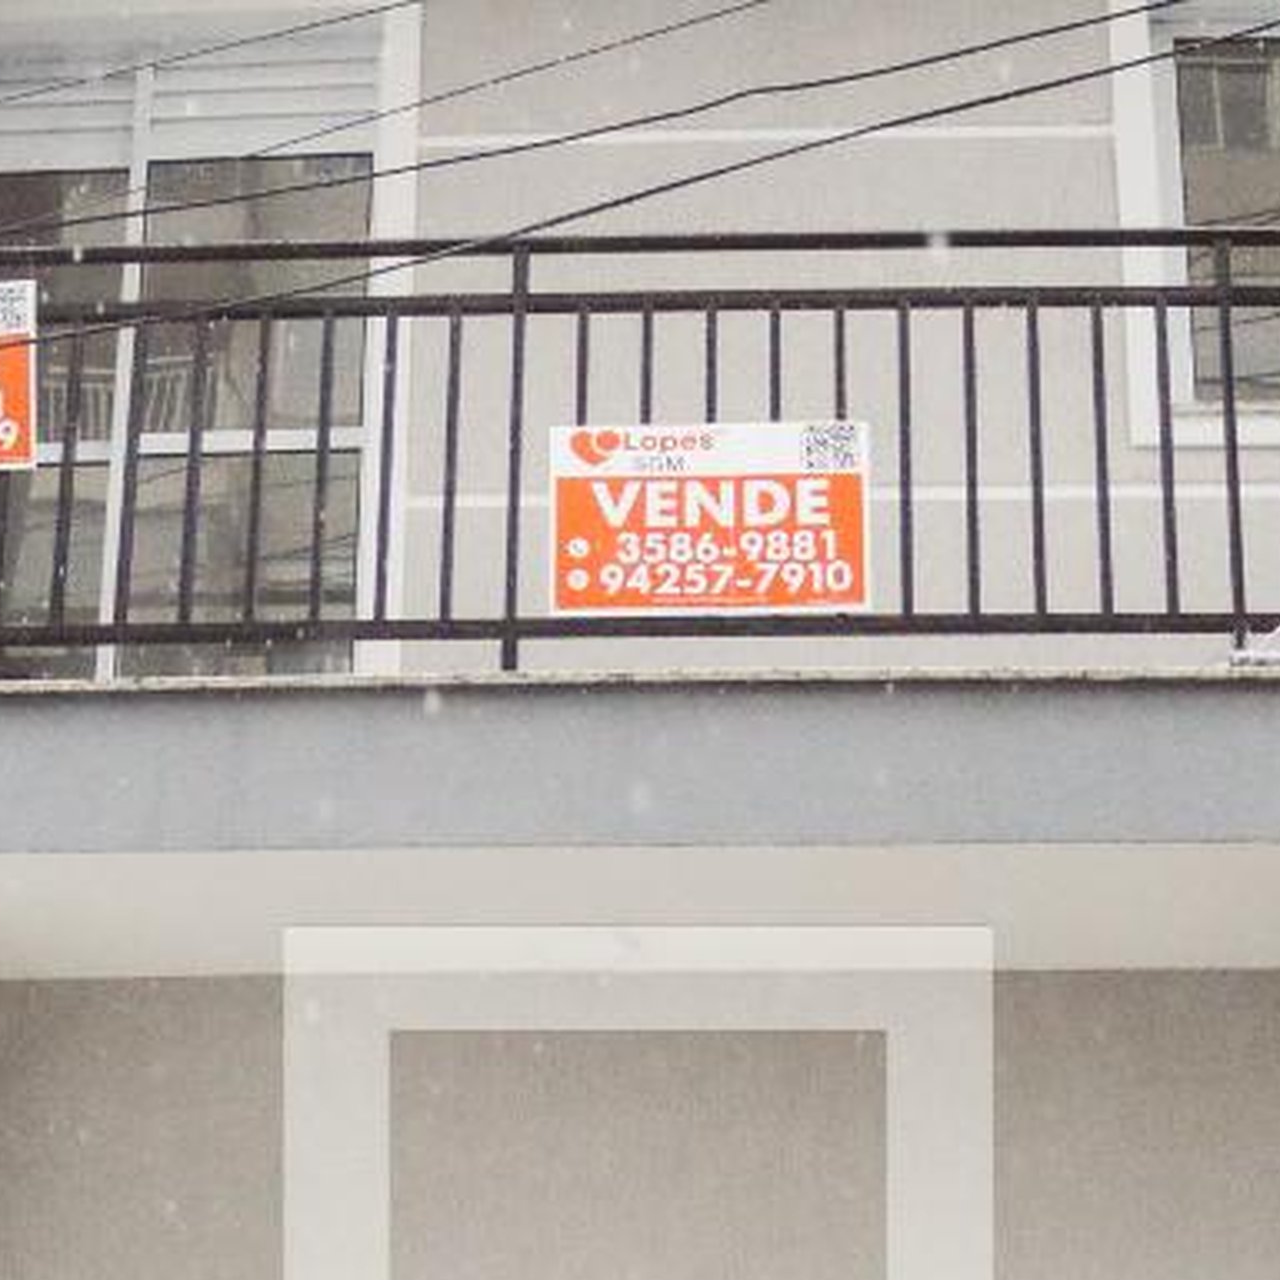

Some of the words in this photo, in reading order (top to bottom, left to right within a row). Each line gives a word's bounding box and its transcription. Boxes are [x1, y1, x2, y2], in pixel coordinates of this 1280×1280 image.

[623, 431, 715, 454] Lopes
[591, 479, 832, 529] VENDE
[616, 530, 838, 564] 3586-9881
[599, 562, 852, 595] 94257-7910
